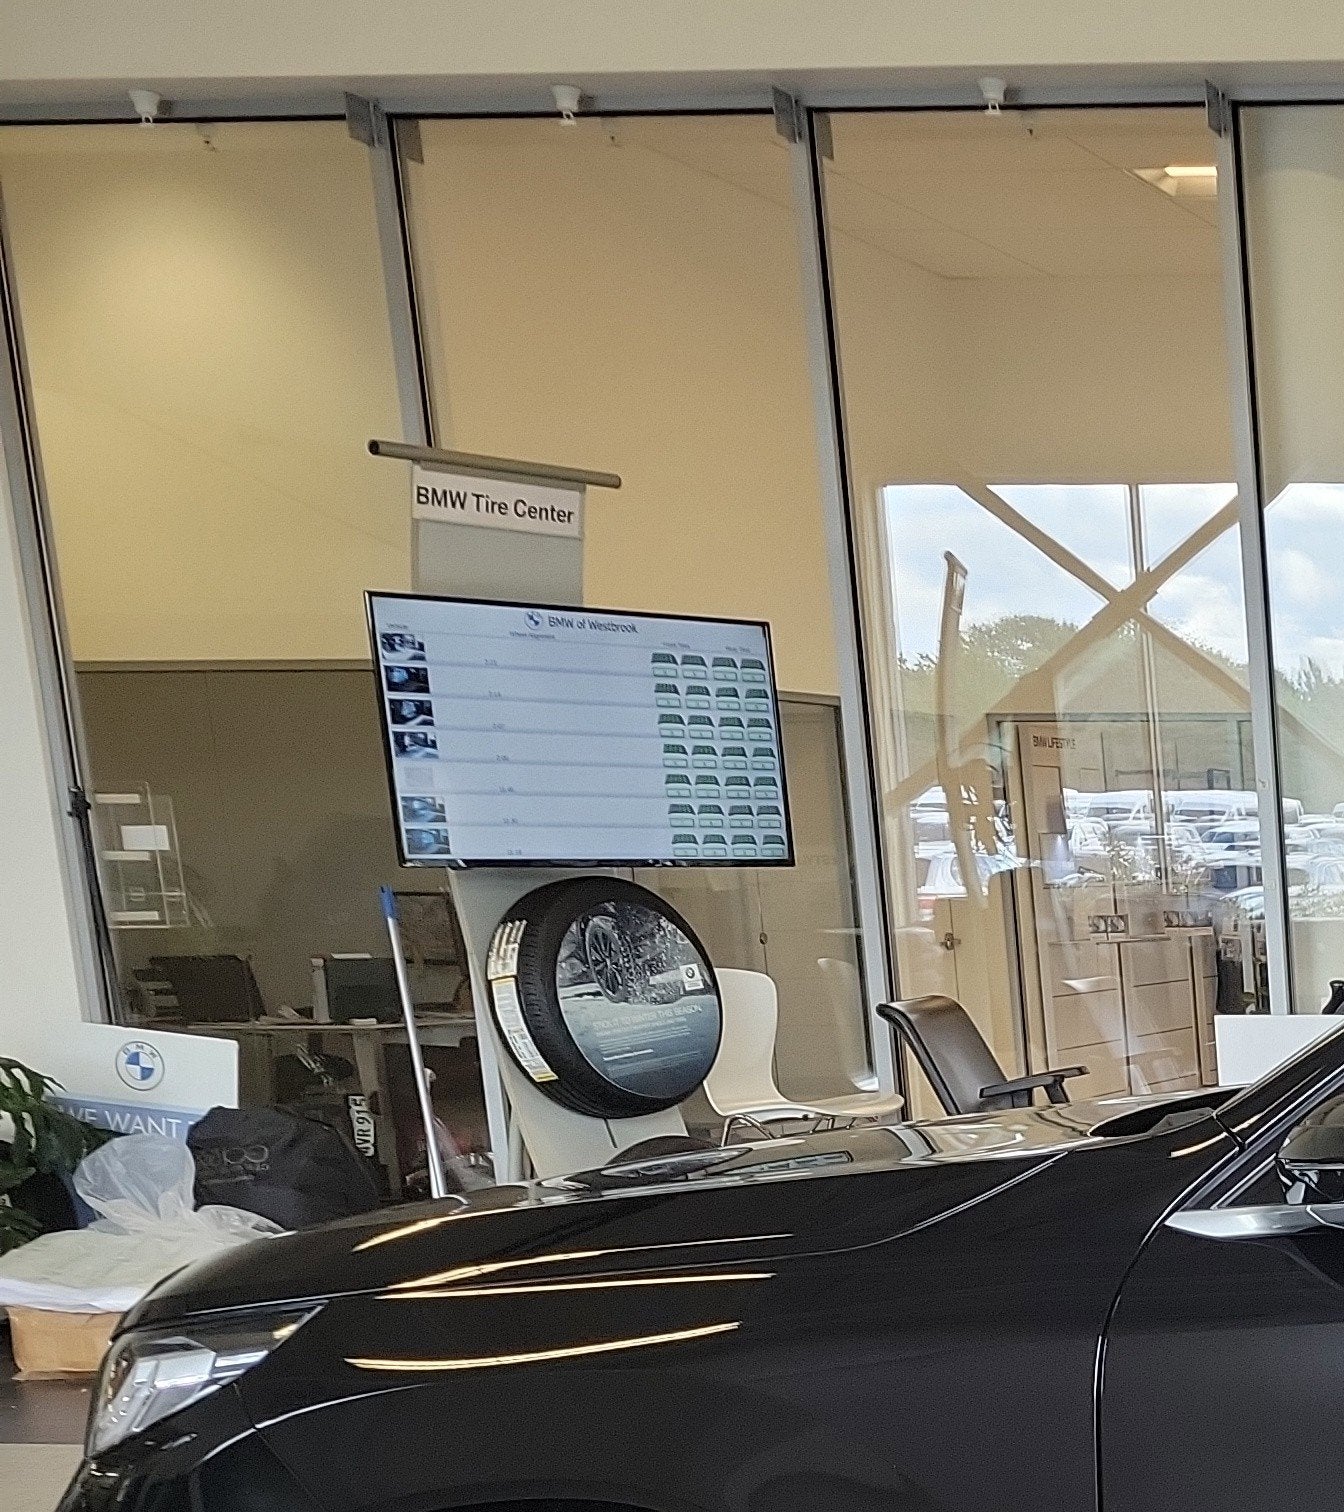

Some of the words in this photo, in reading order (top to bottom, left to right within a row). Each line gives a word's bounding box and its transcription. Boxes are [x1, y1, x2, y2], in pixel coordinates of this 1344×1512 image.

[416, 485, 467, 511] BMW
[471, 492, 509, 516] Tire
[513, 498, 575, 525] Center
[548, 615, 574, 629] BMW
[576, 618, 586, 630] of
[104, 1110, 182, 1139] WANT
